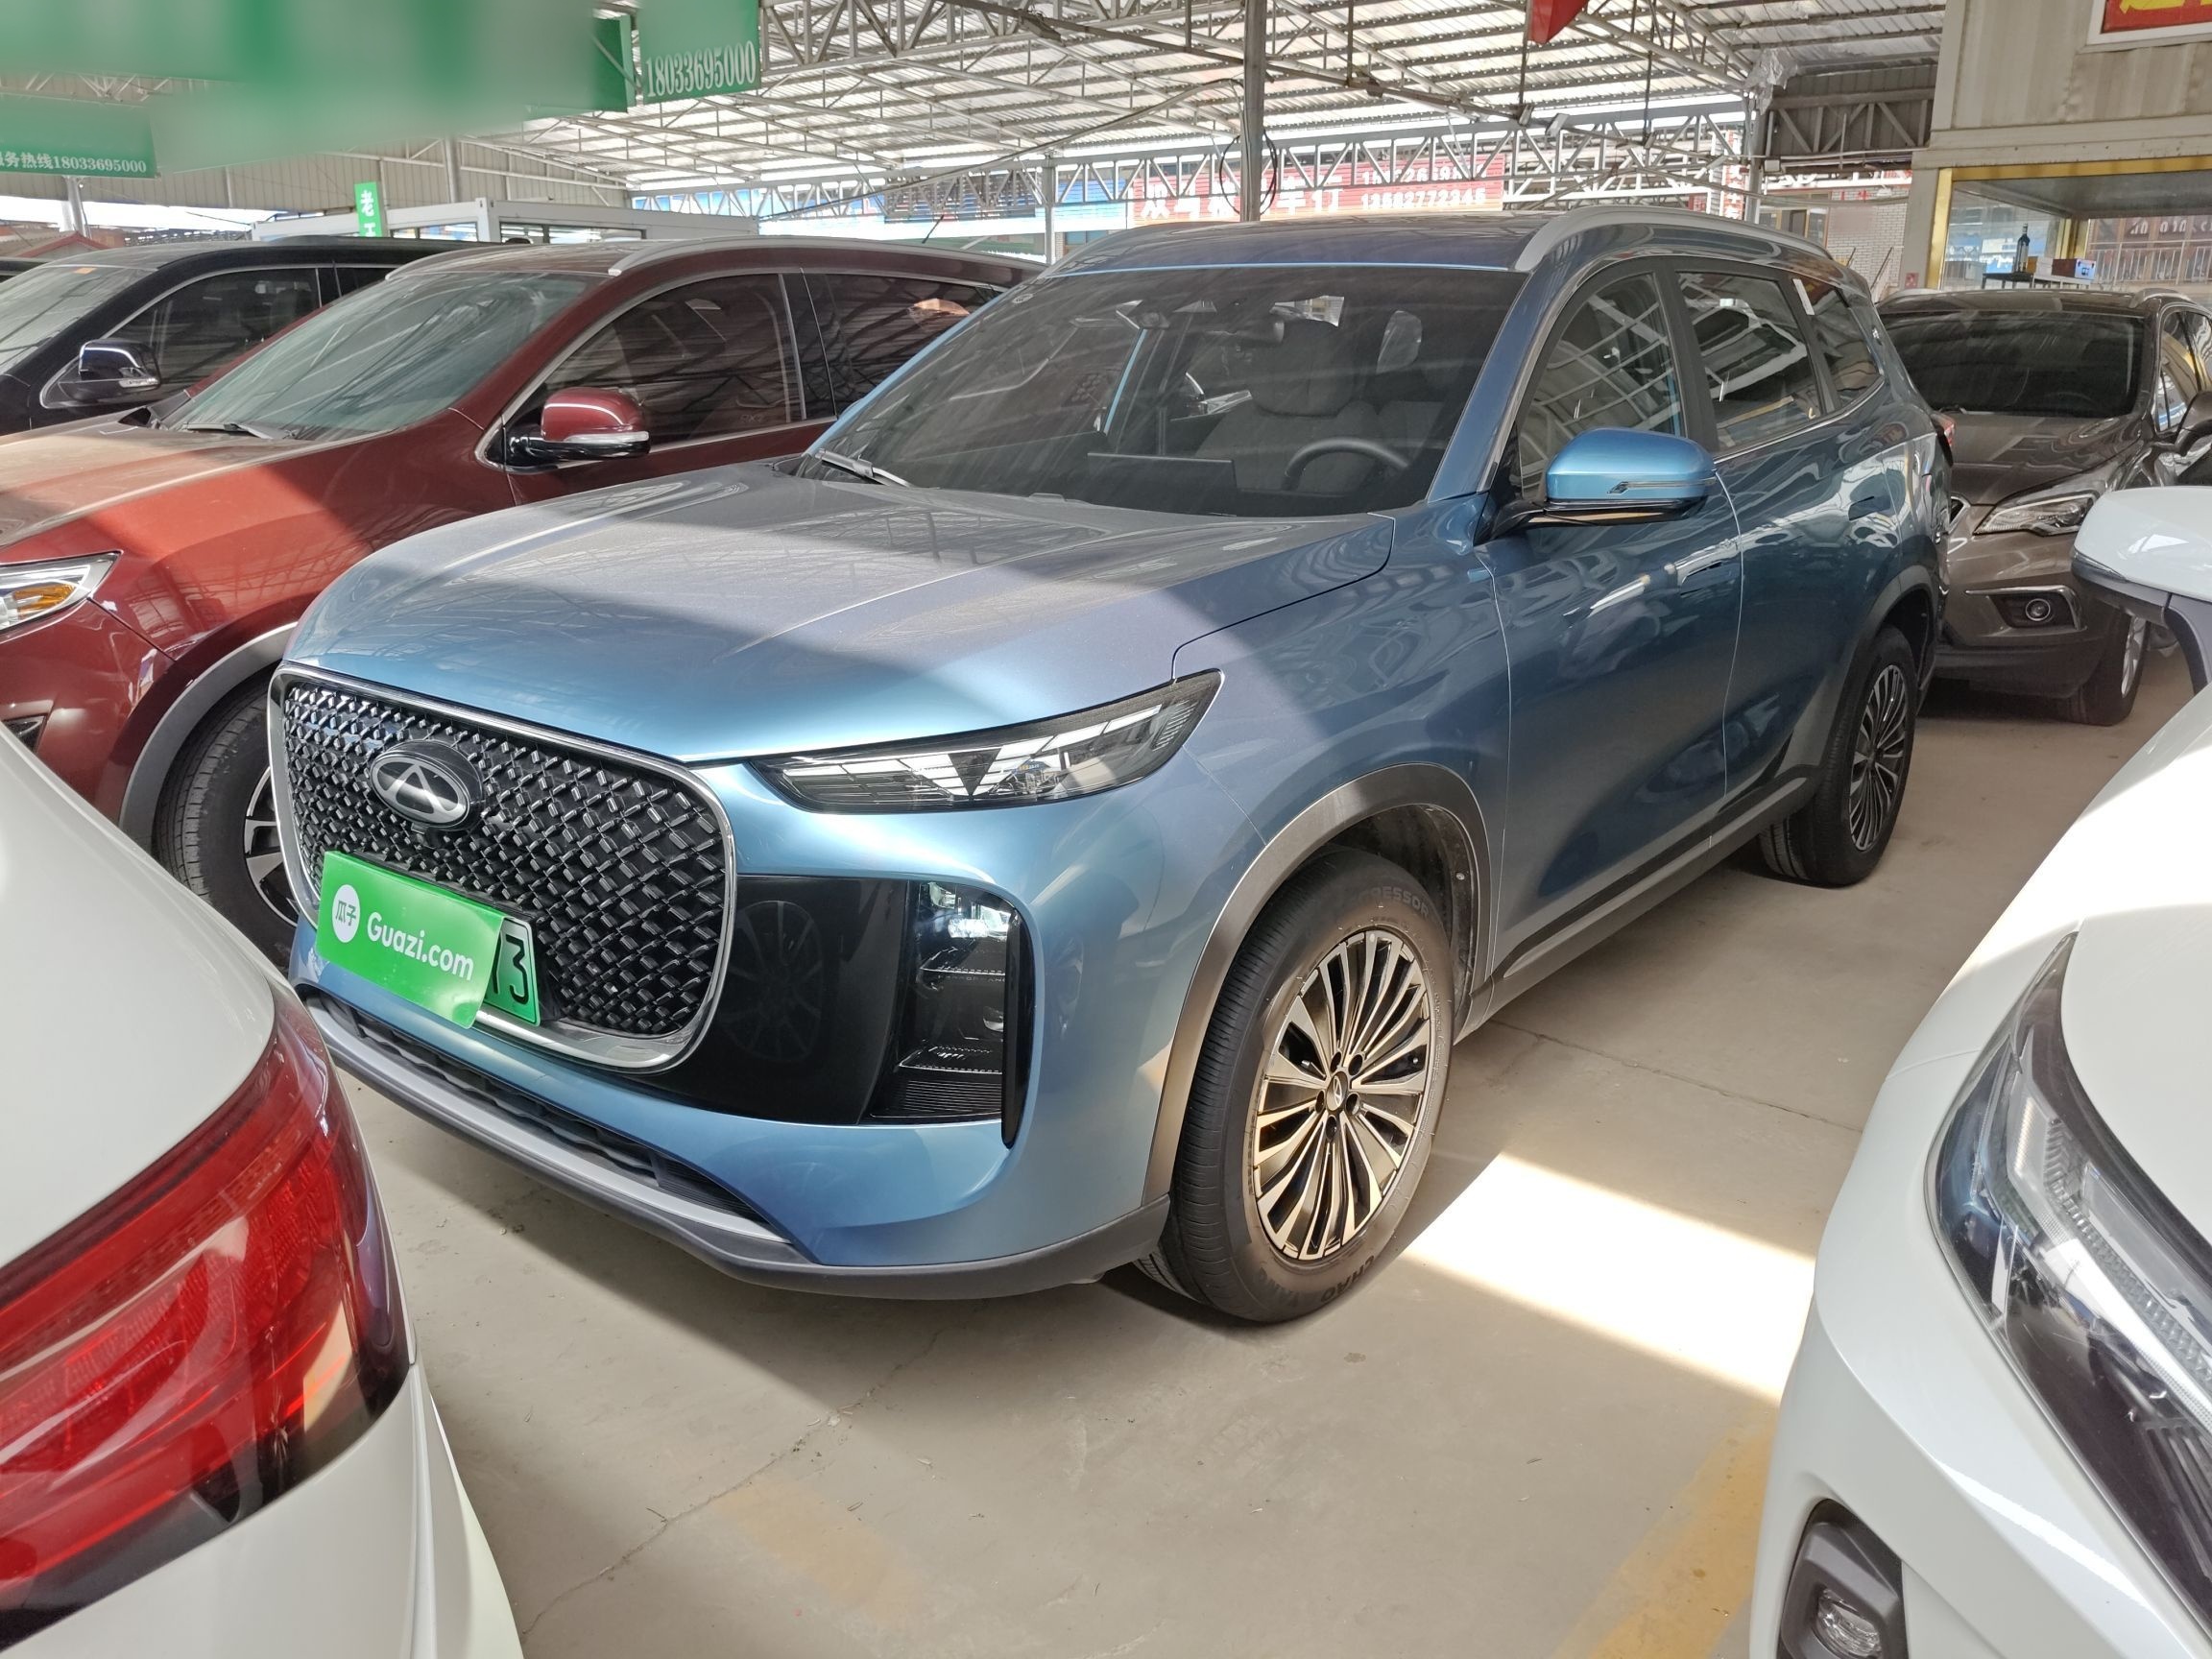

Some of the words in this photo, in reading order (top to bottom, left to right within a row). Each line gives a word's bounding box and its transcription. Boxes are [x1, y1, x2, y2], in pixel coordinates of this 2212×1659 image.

[646, 40, 757, 97] 18033695000
[335, 900, 357, 927] 瓜子
[367, 911, 474, 981] Guazi.com
[492, 933, 529, 1005] 3
